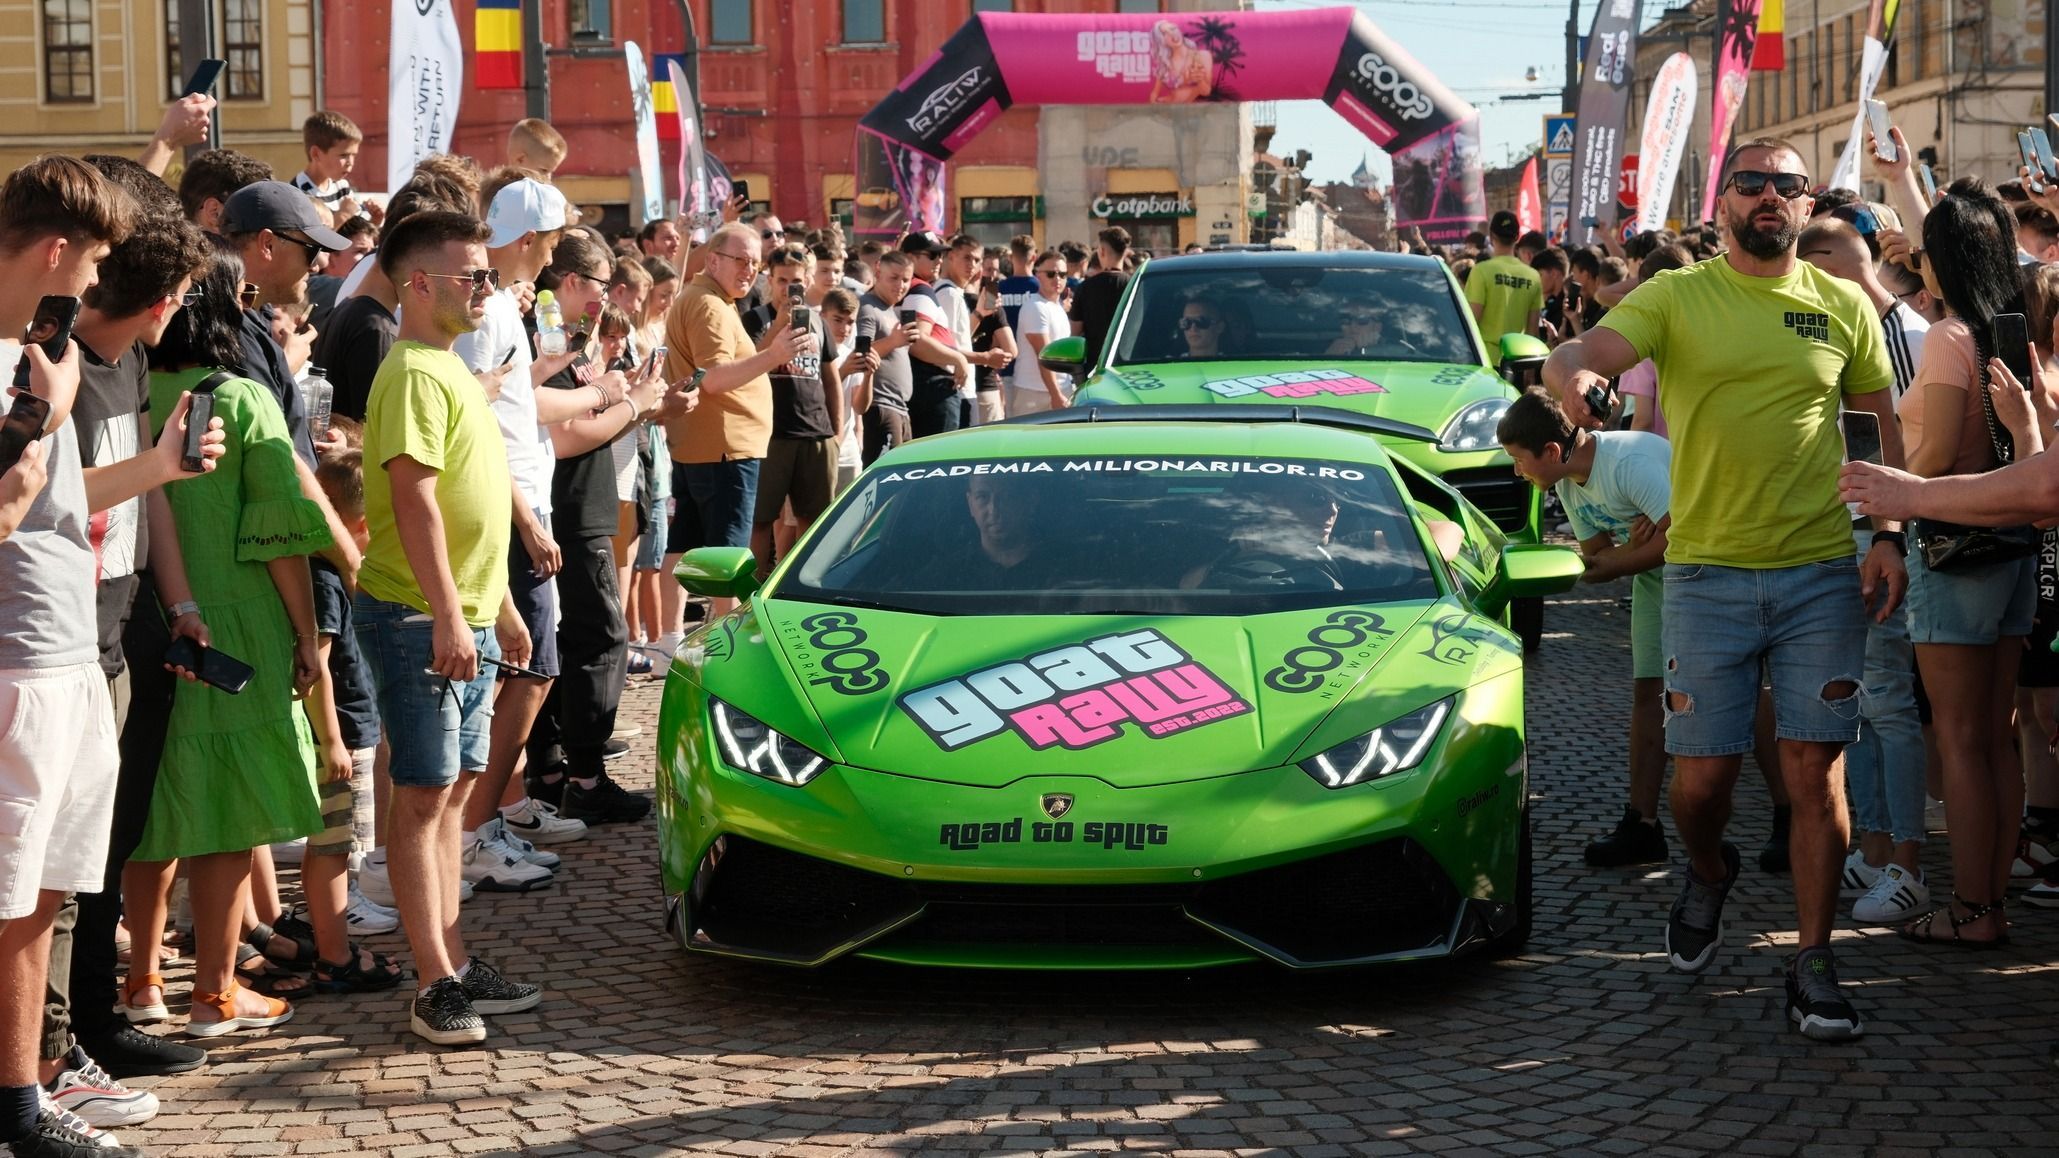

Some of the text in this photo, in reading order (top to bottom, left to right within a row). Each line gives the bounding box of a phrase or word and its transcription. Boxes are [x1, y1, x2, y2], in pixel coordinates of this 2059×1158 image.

[1077, 31, 1150, 61] goat
[915, 68, 980, 132] RALIW
[1117, 196, 1191, 218] otpbank
[1784, 312, 1829, 328] goat
[1202, 369, 1355, 399] goat
[880, 459, 1365, 484] ACADEMIA MILIONARILOR.RO
[780, 619, 819, 679] NETWORK
[1320, 634, 1389, 700] NETWORK
[903, 630, 1185, 748] goat
[1148, 701, 1247, 737] est.2022
[1032, 821, 1074, 843] to
